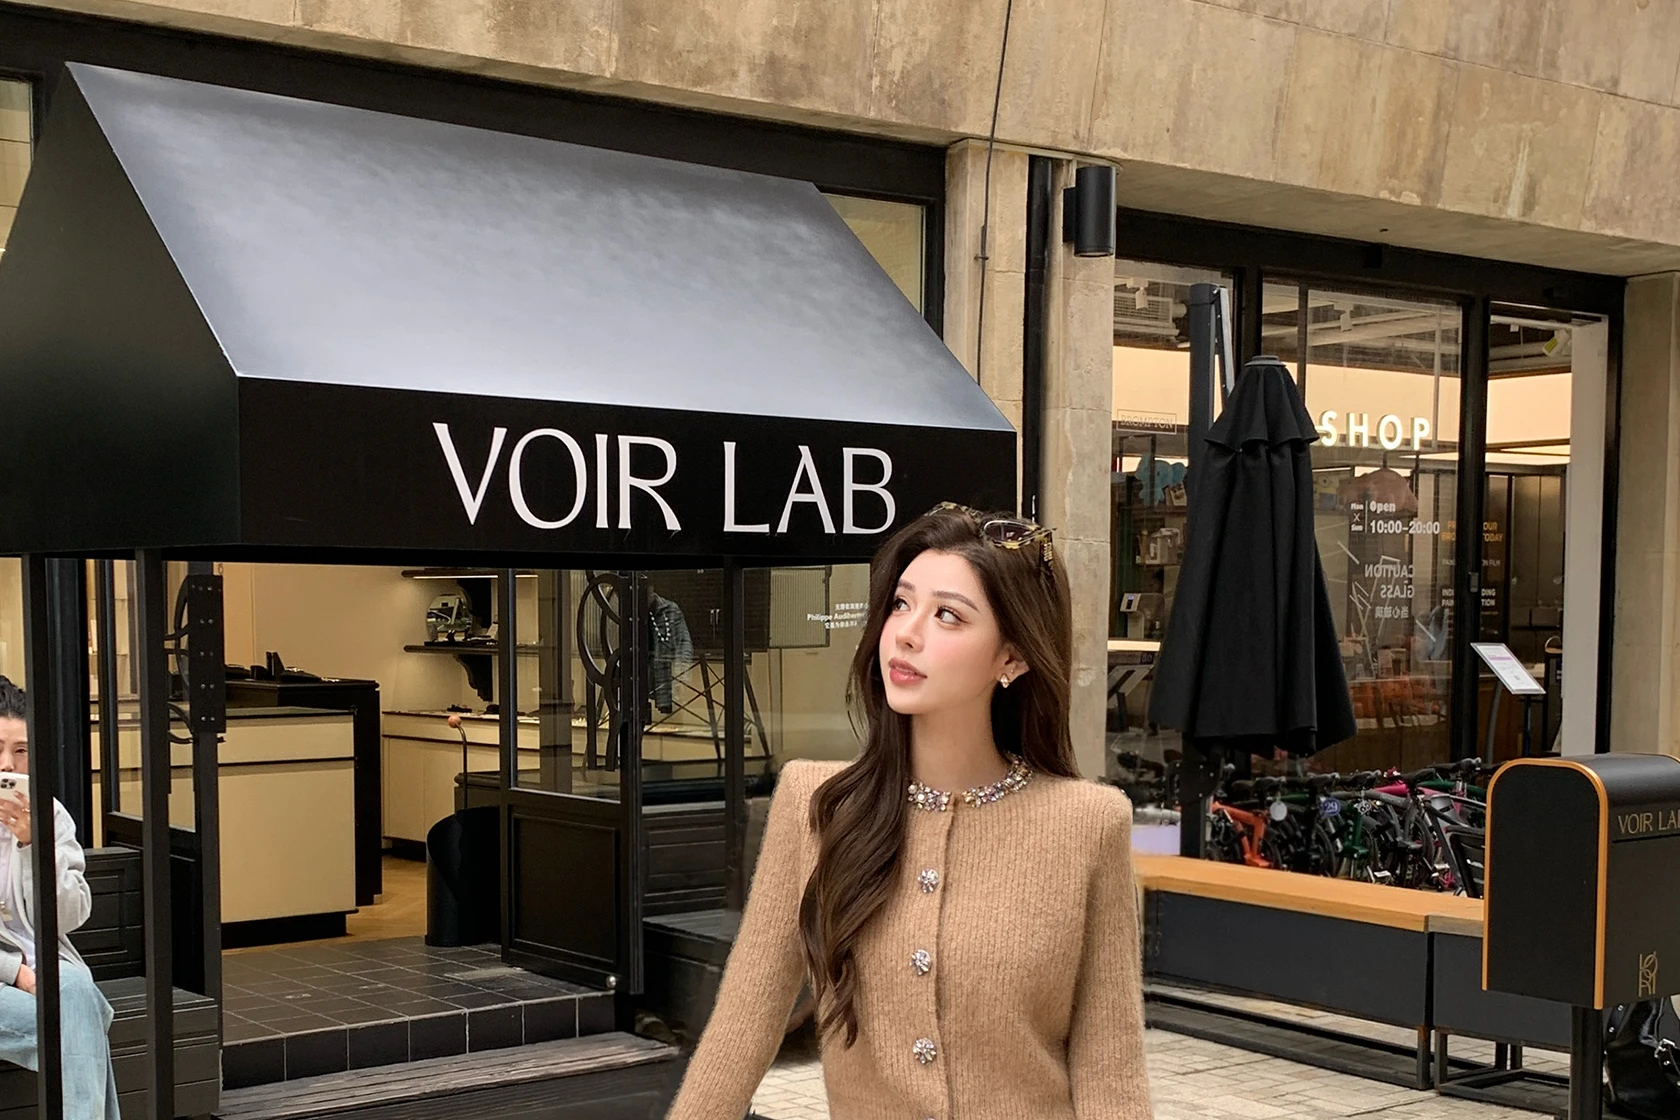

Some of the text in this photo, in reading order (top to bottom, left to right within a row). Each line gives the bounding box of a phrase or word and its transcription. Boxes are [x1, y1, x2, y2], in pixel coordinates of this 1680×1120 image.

[1120, 414, 1173, 429] BROMPTON
[1320, 410, 1430, 451] SHOP
[432, 422, 897, 535] VOIR LAB
[1369, 500, 1396, 514] Open
[1483, 522, 1498, 531] OUR
[807, 613, 833, 622] Philippe
[1324, 801, 1338, 813] 29
[1617, 809, 1680, 834] VOIR LA
